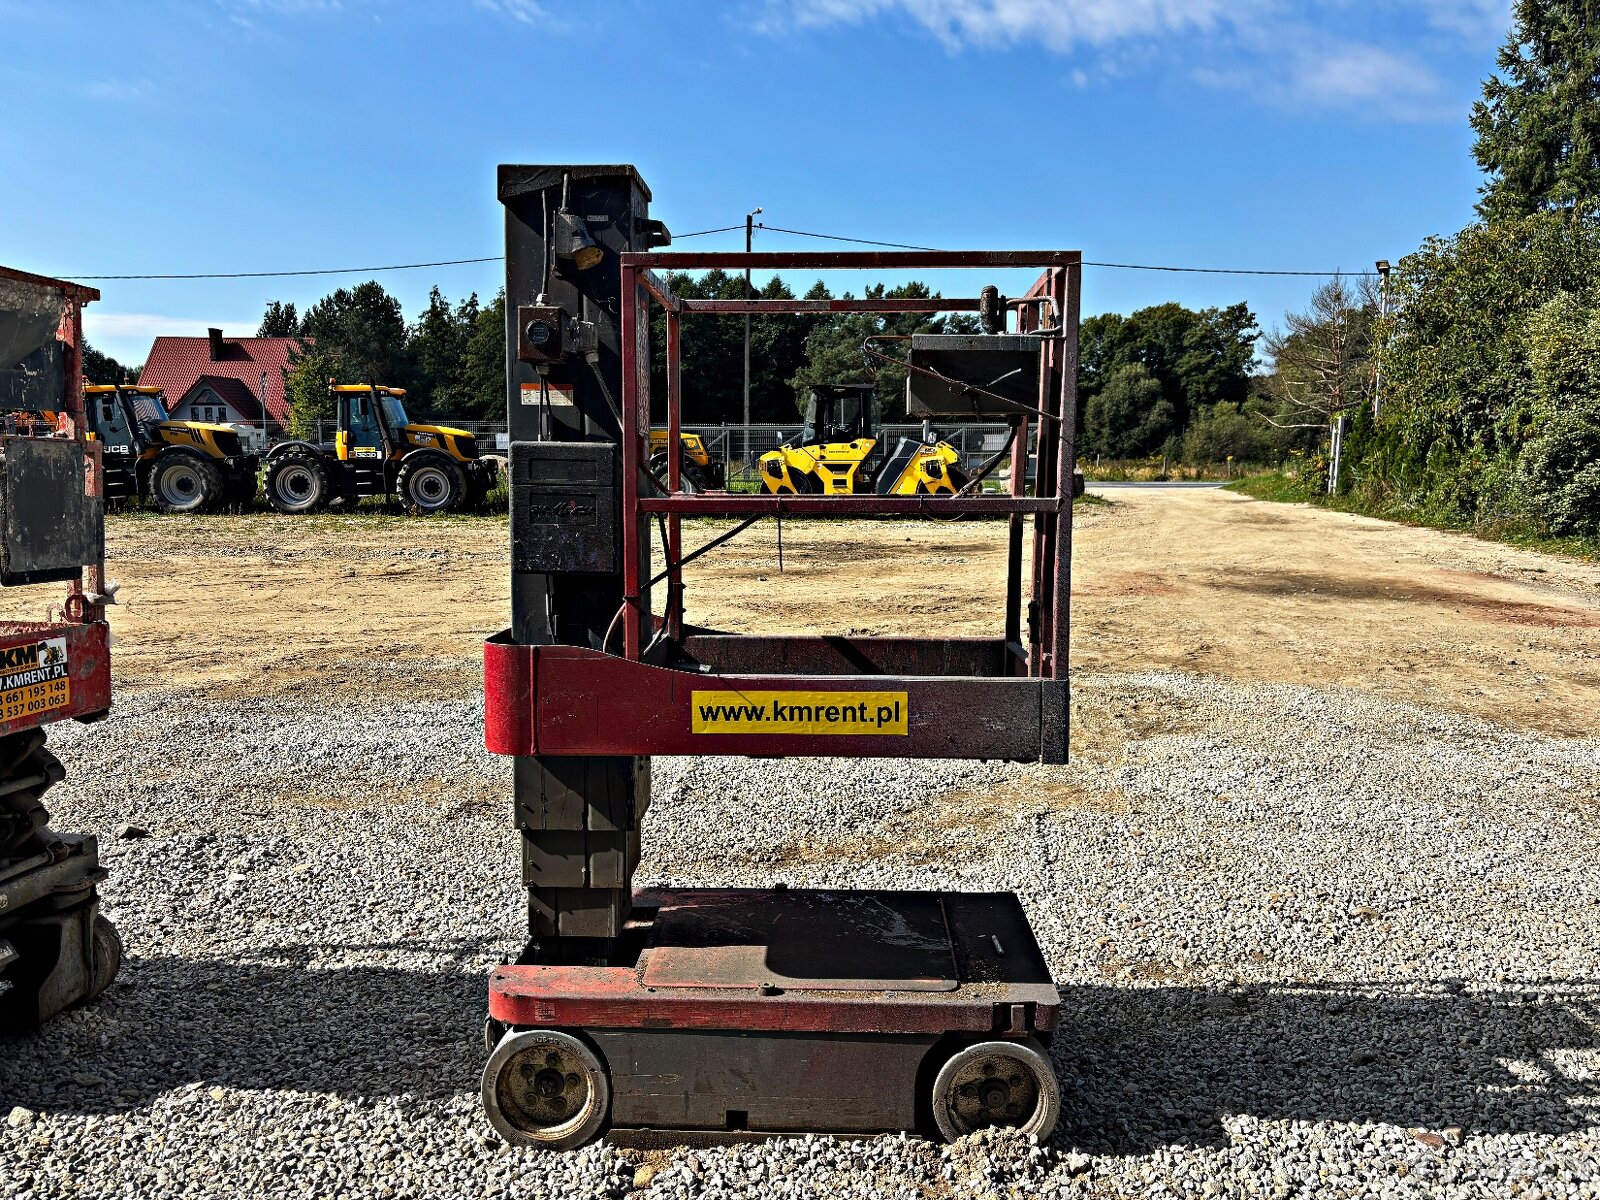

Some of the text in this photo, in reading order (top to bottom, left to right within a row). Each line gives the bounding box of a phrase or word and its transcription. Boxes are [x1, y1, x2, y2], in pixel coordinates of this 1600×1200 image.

[104, 445, 129, 453] JCB
[0, 645, 37, 669] KM
[0, 665, 67, 690] .KMRENT.PL
[6, 691, 23, 703] 661
[28, 686, 46, 698] 195
[49, 681, 66, 693] 148
[7, 703, 24, 717] 537
[28, 698, 46, 711] 003
[49, 693, 66, 706] 063
[699, 700, 900, 728] www.kmrent.pl
